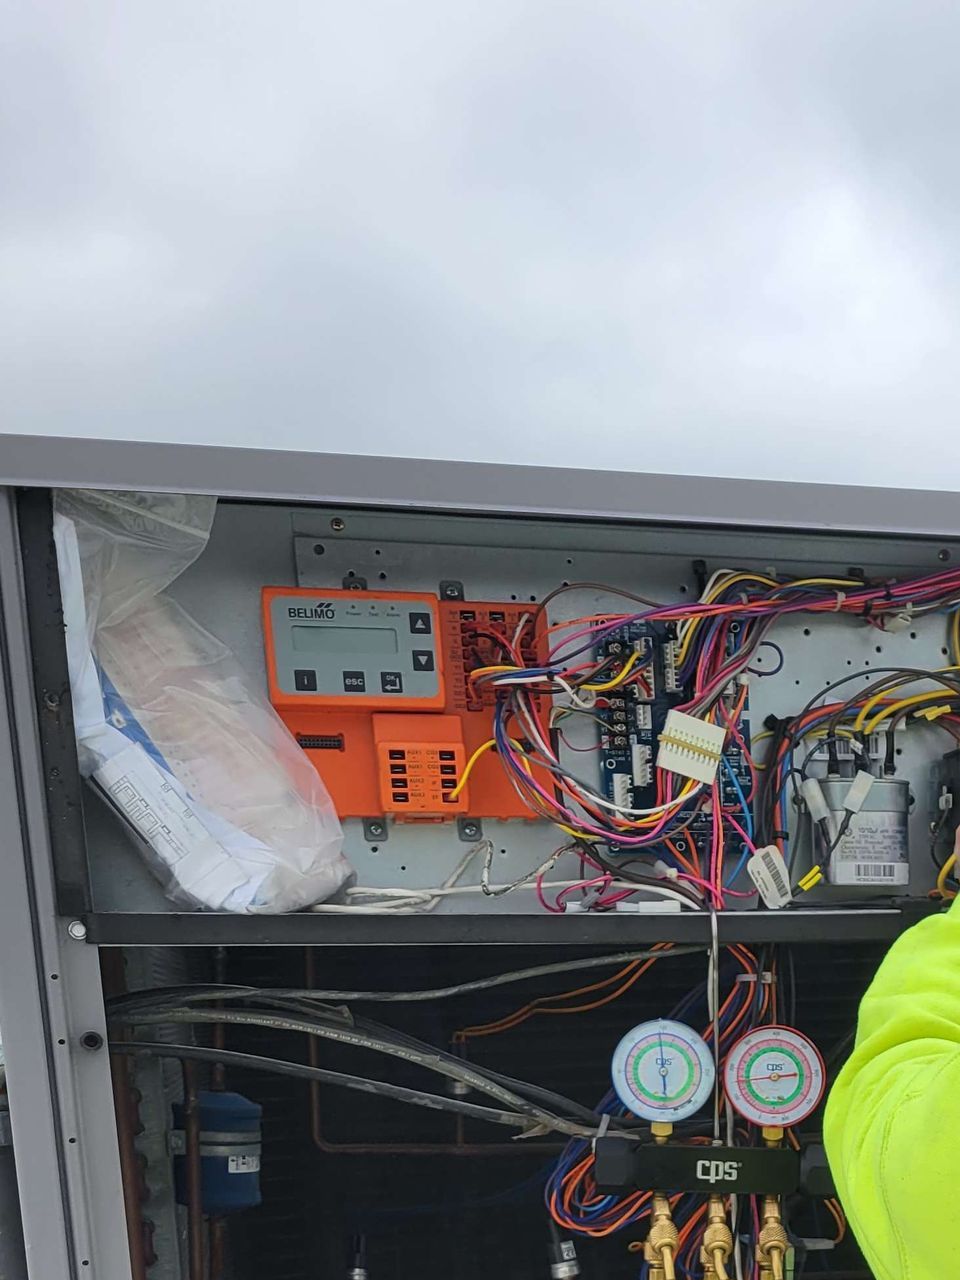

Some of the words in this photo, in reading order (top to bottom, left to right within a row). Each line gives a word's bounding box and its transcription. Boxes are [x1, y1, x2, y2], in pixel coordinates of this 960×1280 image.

[287, 606, 335, 620] BELIMO
[345, 677, 364, 686] esc
[696, 1160, 738, 1183] cps
